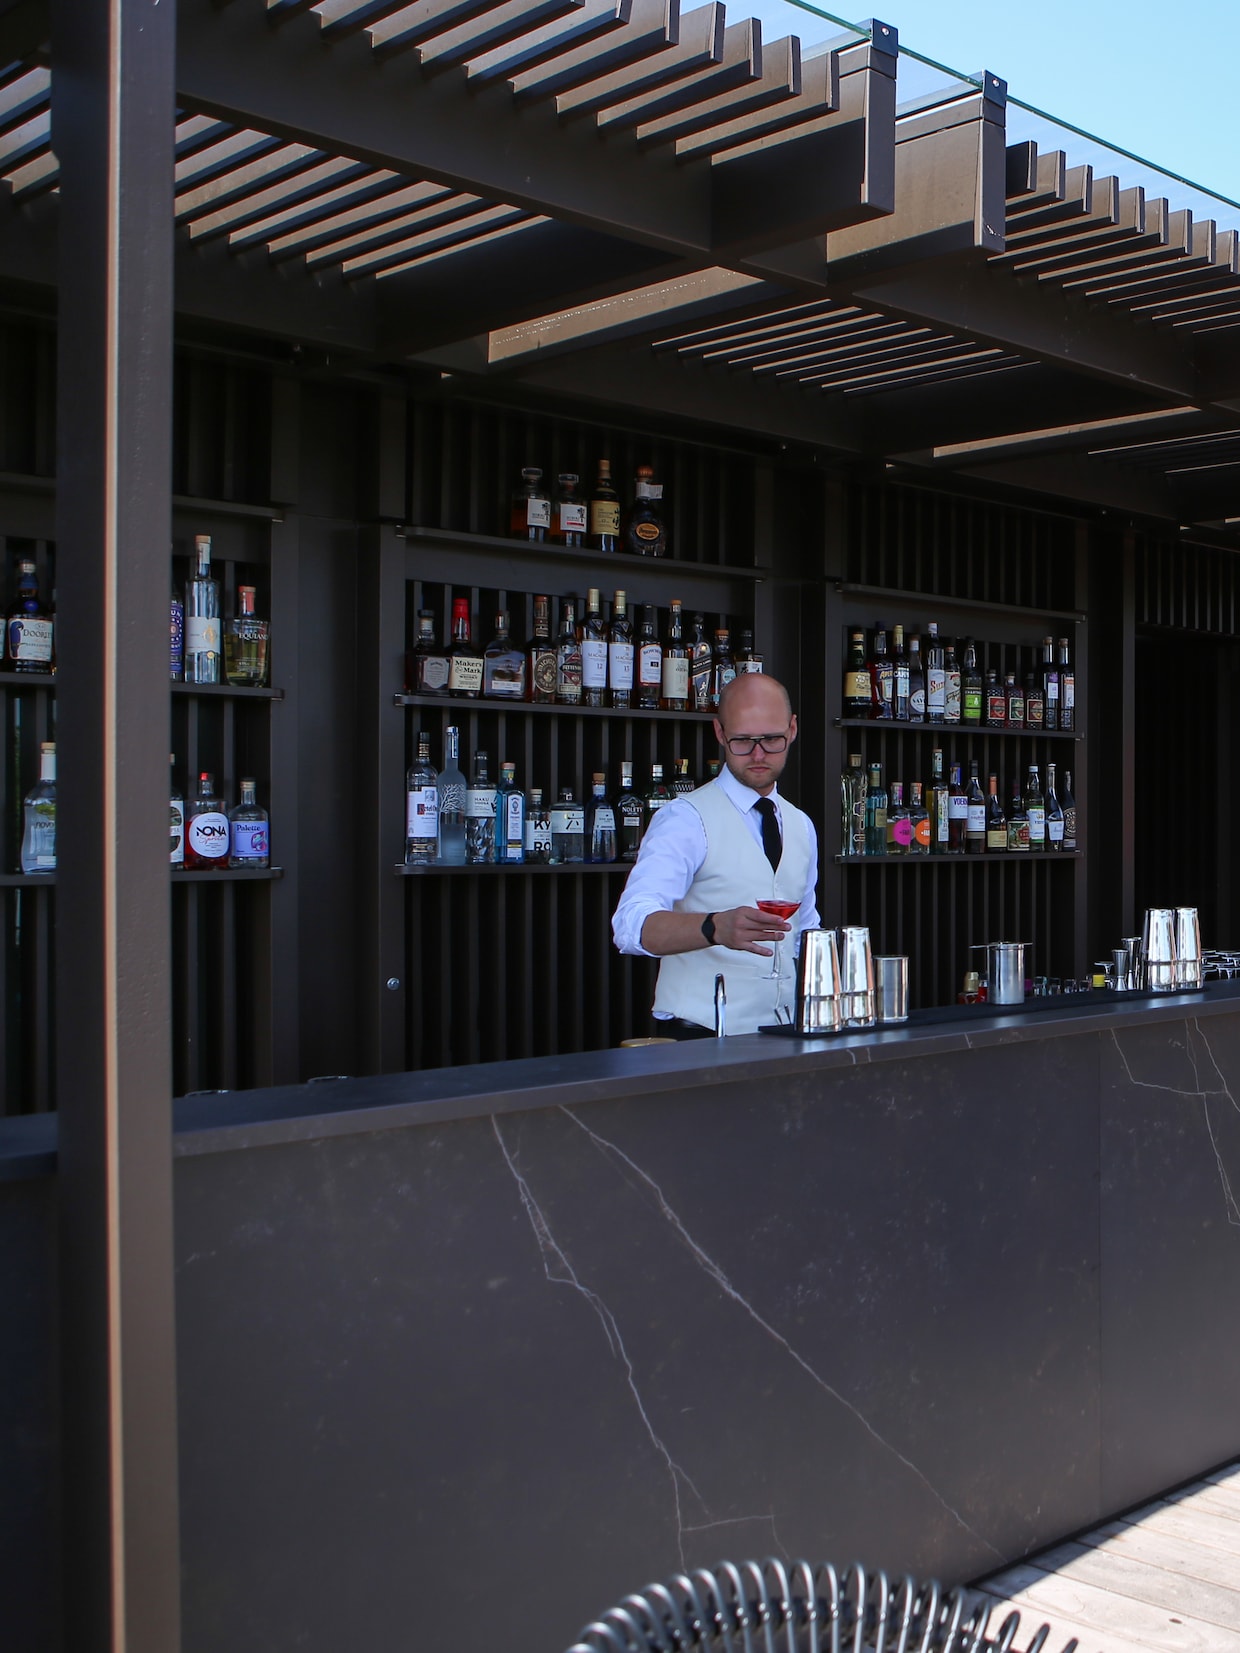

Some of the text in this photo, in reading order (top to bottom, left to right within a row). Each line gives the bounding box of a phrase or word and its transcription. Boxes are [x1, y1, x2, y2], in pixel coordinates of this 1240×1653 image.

[196, 825, 227, 837] NONA
[236, 824, 262, 832] Palette
[534, 820, 551, 831] KY
